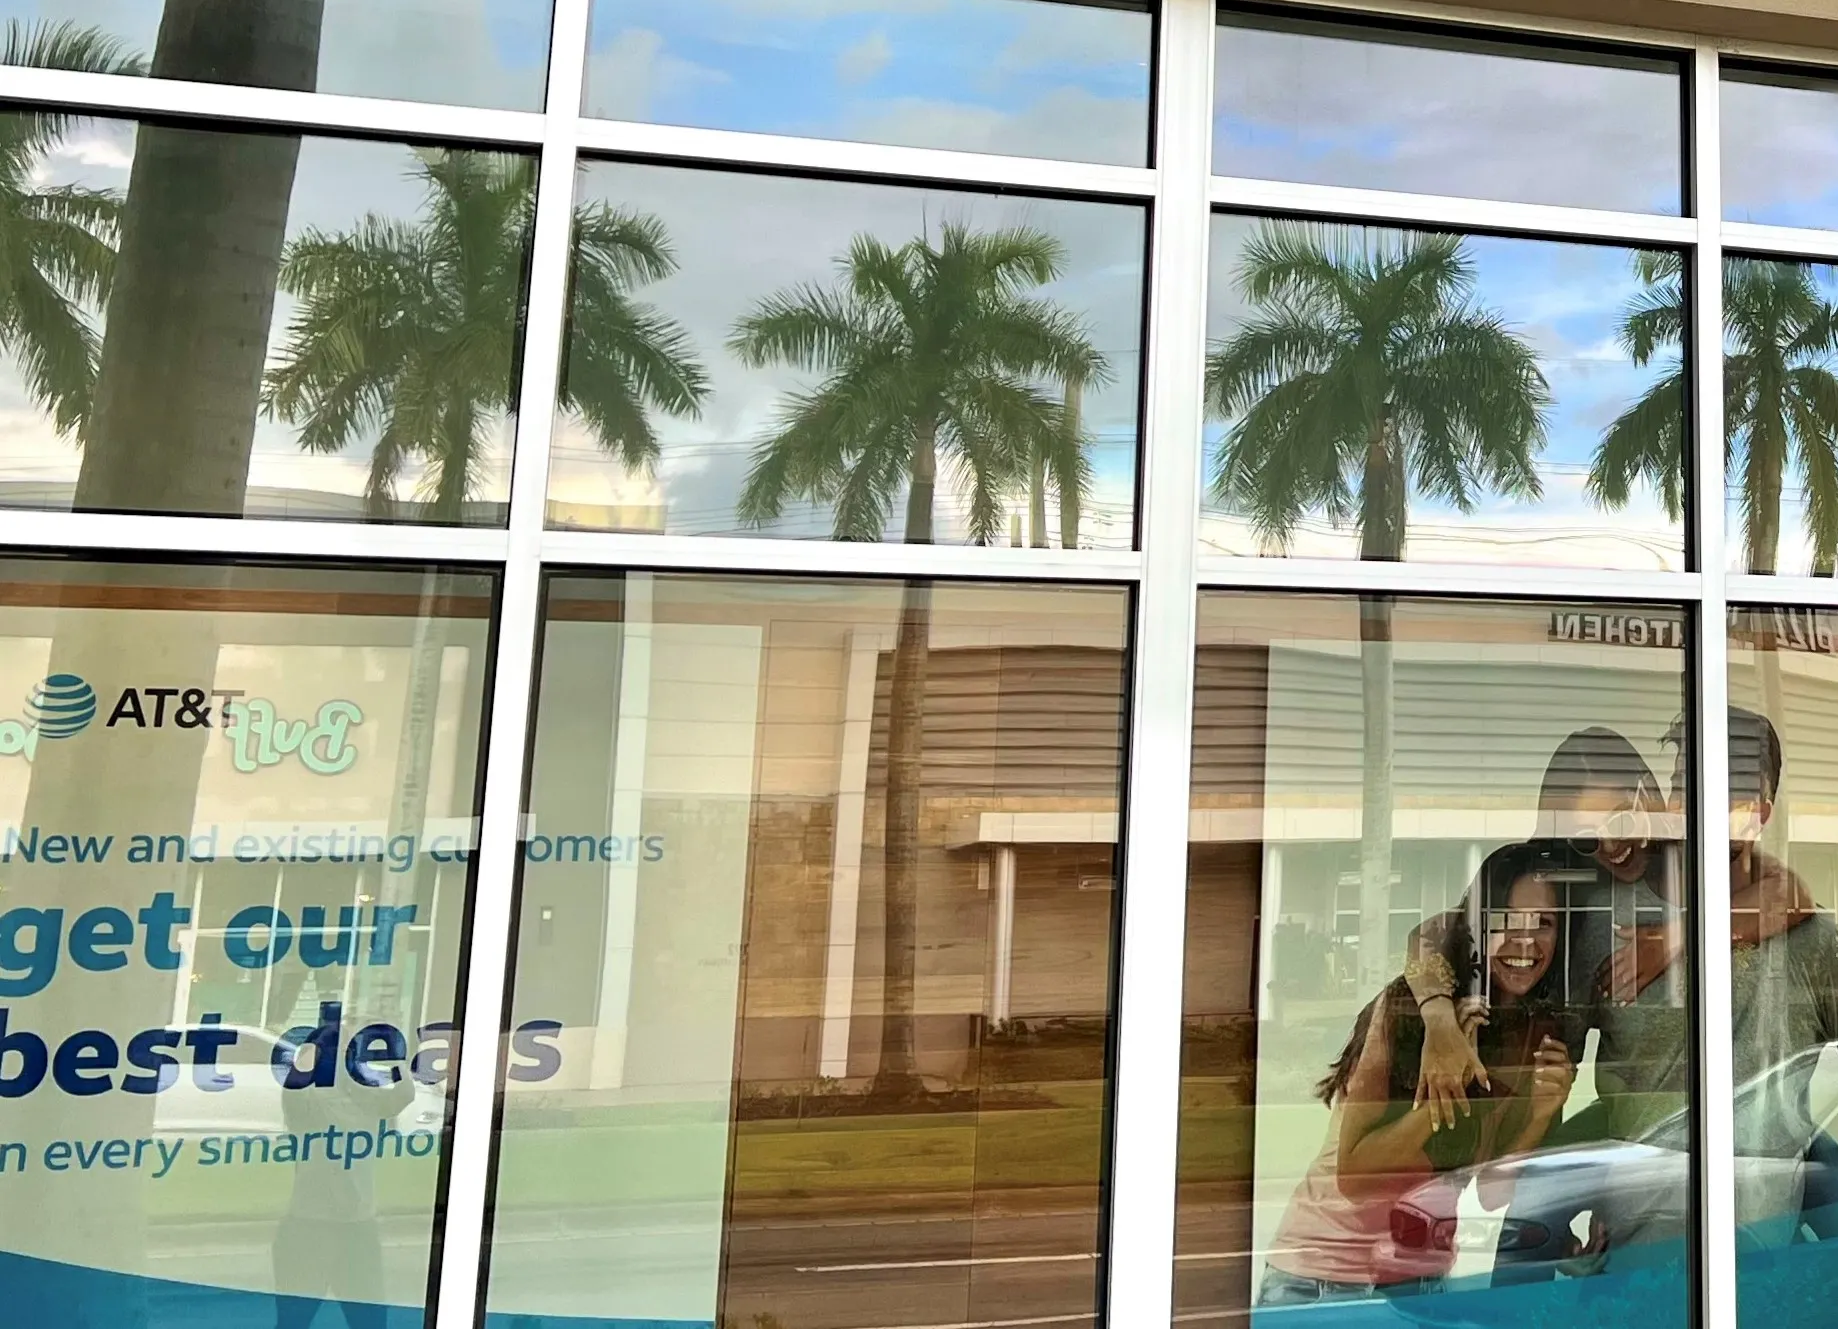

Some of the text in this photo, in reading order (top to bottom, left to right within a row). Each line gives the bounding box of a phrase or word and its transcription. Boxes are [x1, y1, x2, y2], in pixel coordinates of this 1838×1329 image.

[106, 688, 245, 729] AT&T
[1, 825, 664, 873] New and existing cuomers
[0, 892, 416, 997] get our
[0, 1002, 562, 1098] best deas
[43, 1134, 184, 1178] every
[197, 1118, 441, 1170] smartpho
